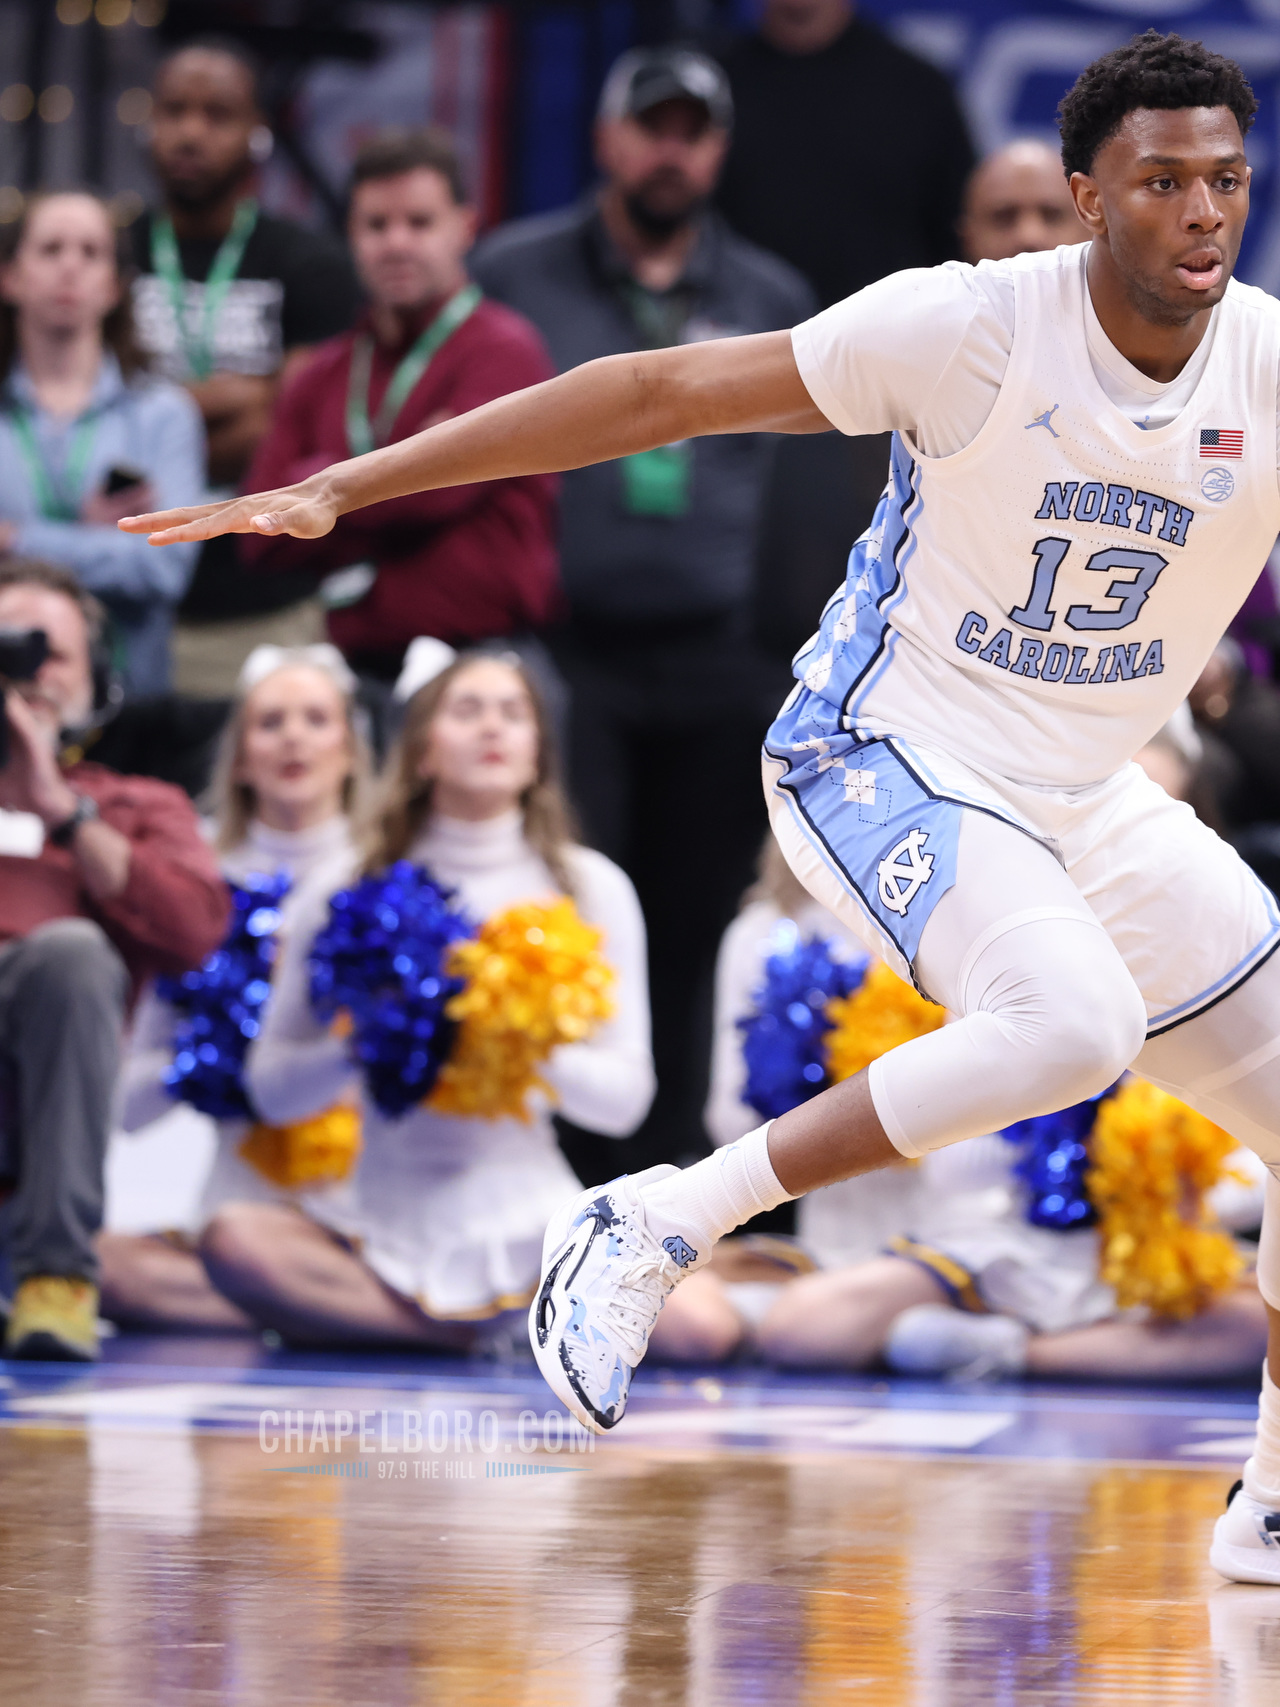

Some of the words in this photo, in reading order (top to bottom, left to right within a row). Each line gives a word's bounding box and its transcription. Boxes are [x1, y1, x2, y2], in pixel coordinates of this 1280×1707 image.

[1034, 482, 1194, 547] NORTH
[1008, 536, 1170, 632] 13
[955, 611, 1165, 684] CAROLINA
